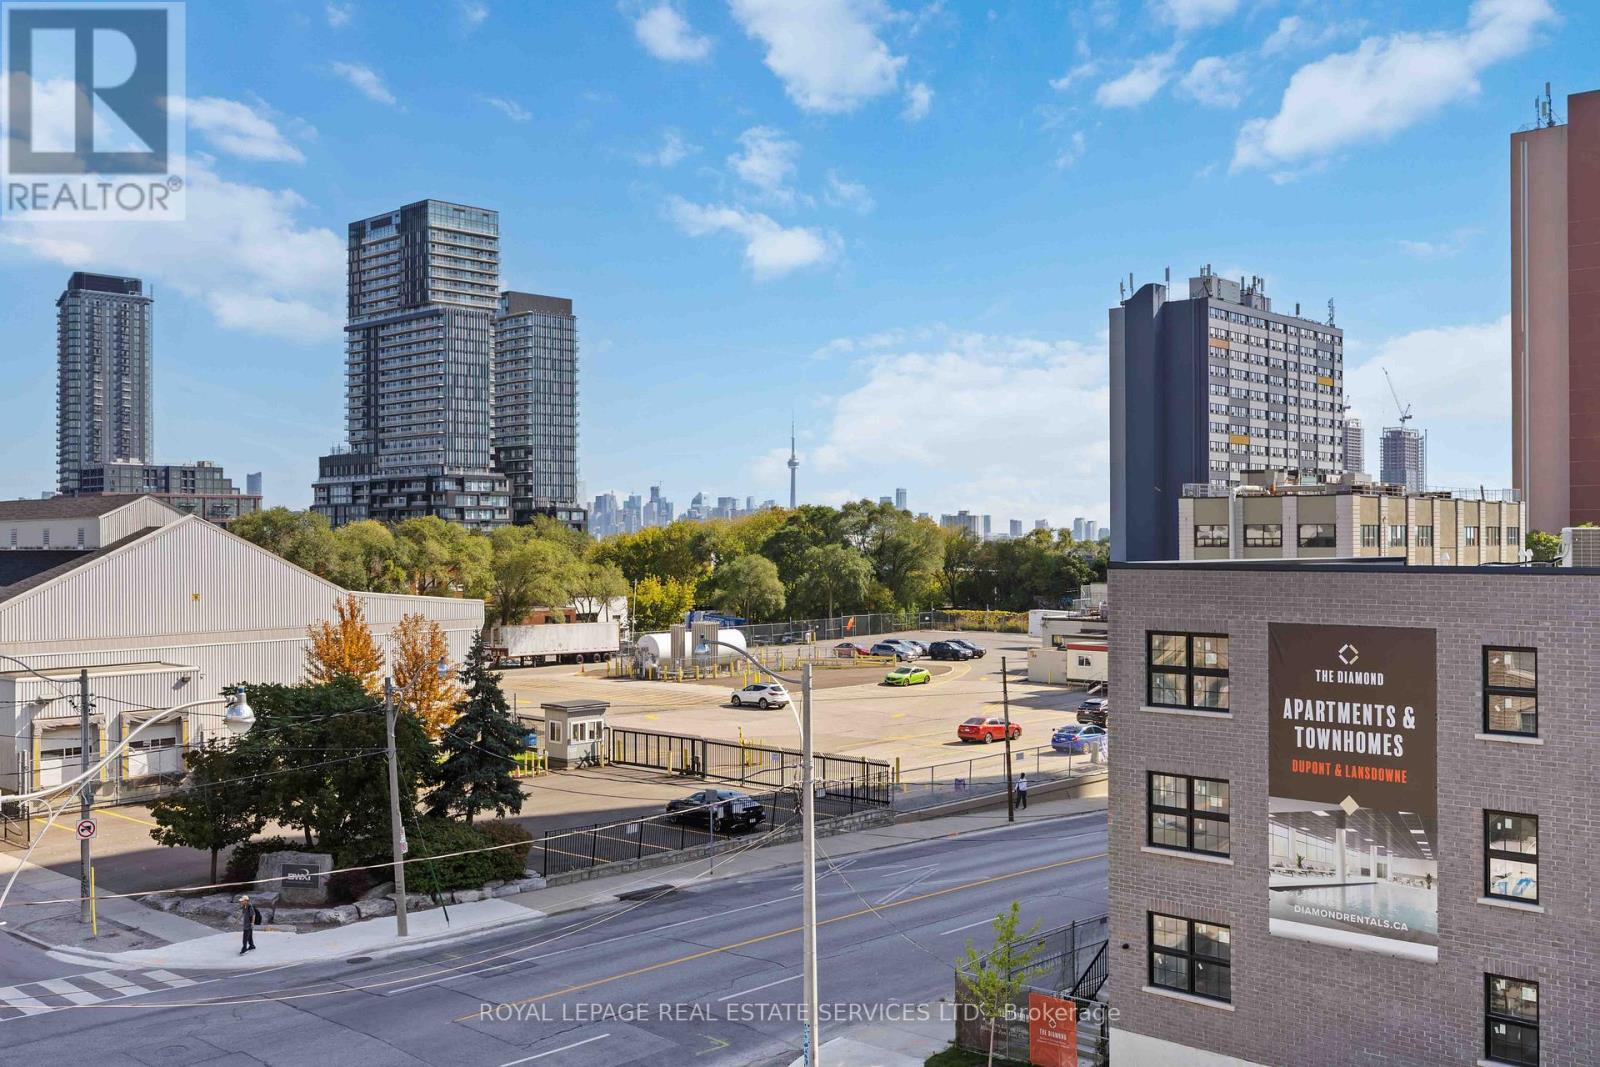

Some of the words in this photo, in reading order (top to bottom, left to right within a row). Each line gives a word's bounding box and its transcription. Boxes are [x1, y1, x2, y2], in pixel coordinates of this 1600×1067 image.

[1315, 669, 1334, 683] THE
[1337, 670, 1384, 686] DIAMOND
[1283, 698, 1396, 728] APARTMENTS
[1402, 706, 1416, 729] &
[1295, 726, 1404, 757] TOWNHOMES
[1292, 759, 1331, 776] DUPONT
[1334, 763, 1342, 777] &
[1345, 764, 1407, 784] LANSDOWNE
[1294, 904, 1409, 932] DIAMONDRENTALS.CA
